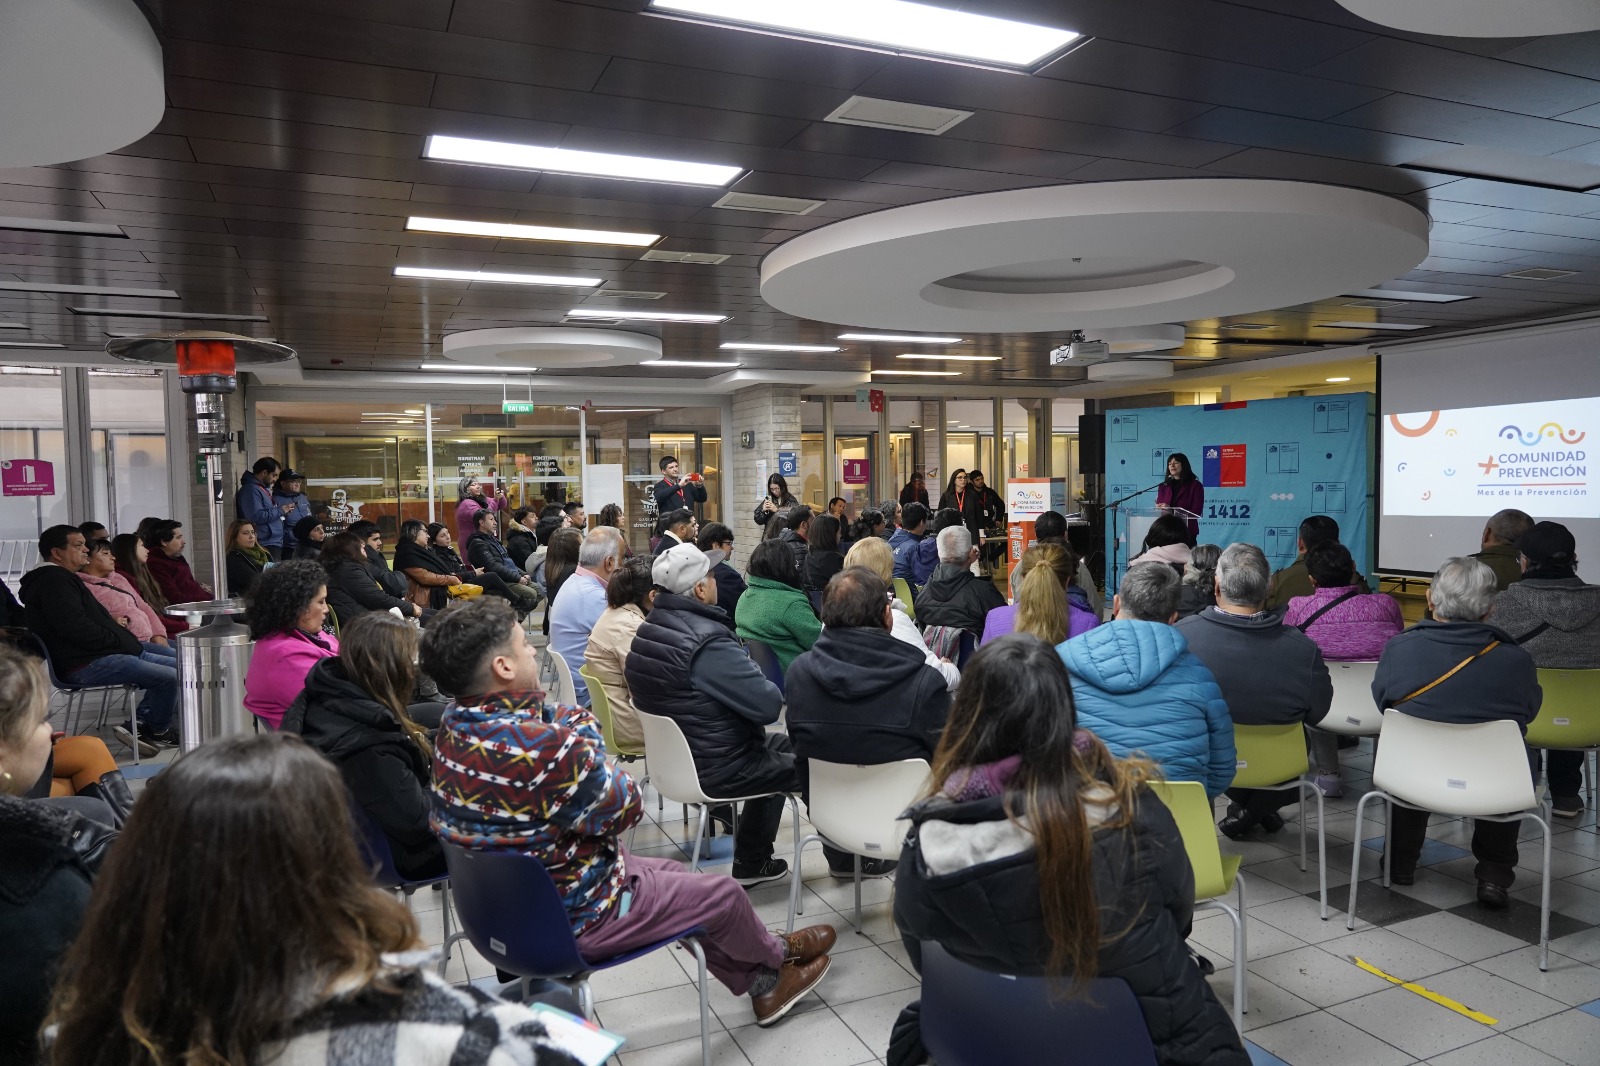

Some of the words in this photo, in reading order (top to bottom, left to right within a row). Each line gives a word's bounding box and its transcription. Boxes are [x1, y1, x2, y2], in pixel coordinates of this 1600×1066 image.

[1498, 450, 1586, 464] COMUNIDAD
[1499, 464, 1586, 478] PREVENCIÓN
[1527, 488, 1587, 496] Prevención
[1208, 504, 1251, 519] 1412
